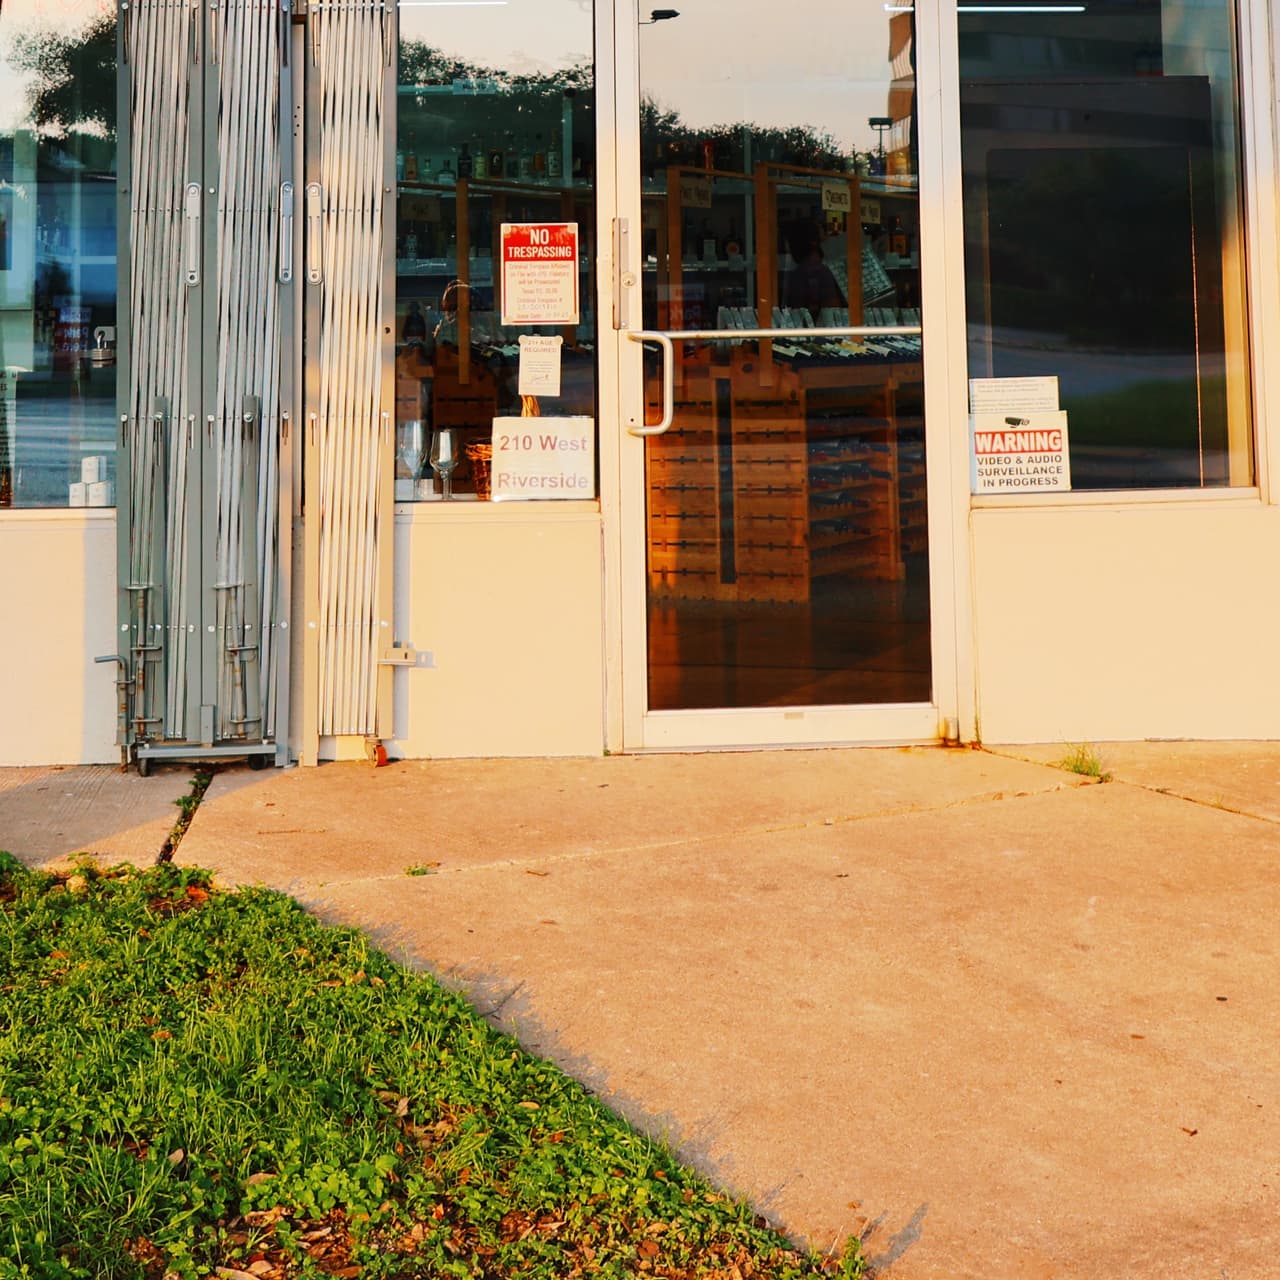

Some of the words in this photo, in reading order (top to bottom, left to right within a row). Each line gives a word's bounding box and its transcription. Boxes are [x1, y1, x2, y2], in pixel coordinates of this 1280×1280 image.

[530, 228, 550, 245] NO
[508, 246, 571, 258] TRESPASSING
[500, 435, 533, 451] 210
[539, 435, 587, 451] West
[975, 431, 1062, 453] WARNING
[977, 456, 1011, 465] VIDEO
[1015, 456, 1024, 465] &
[1027, 454, 1062, 464] AUDIO
[977, 465, 1063, 477] SURVEILLANCE
[497, 473, 589, 489] Riverside
[983, 478, 995, 487] IN
[999, 477, 1059, 487] PROGRESS
